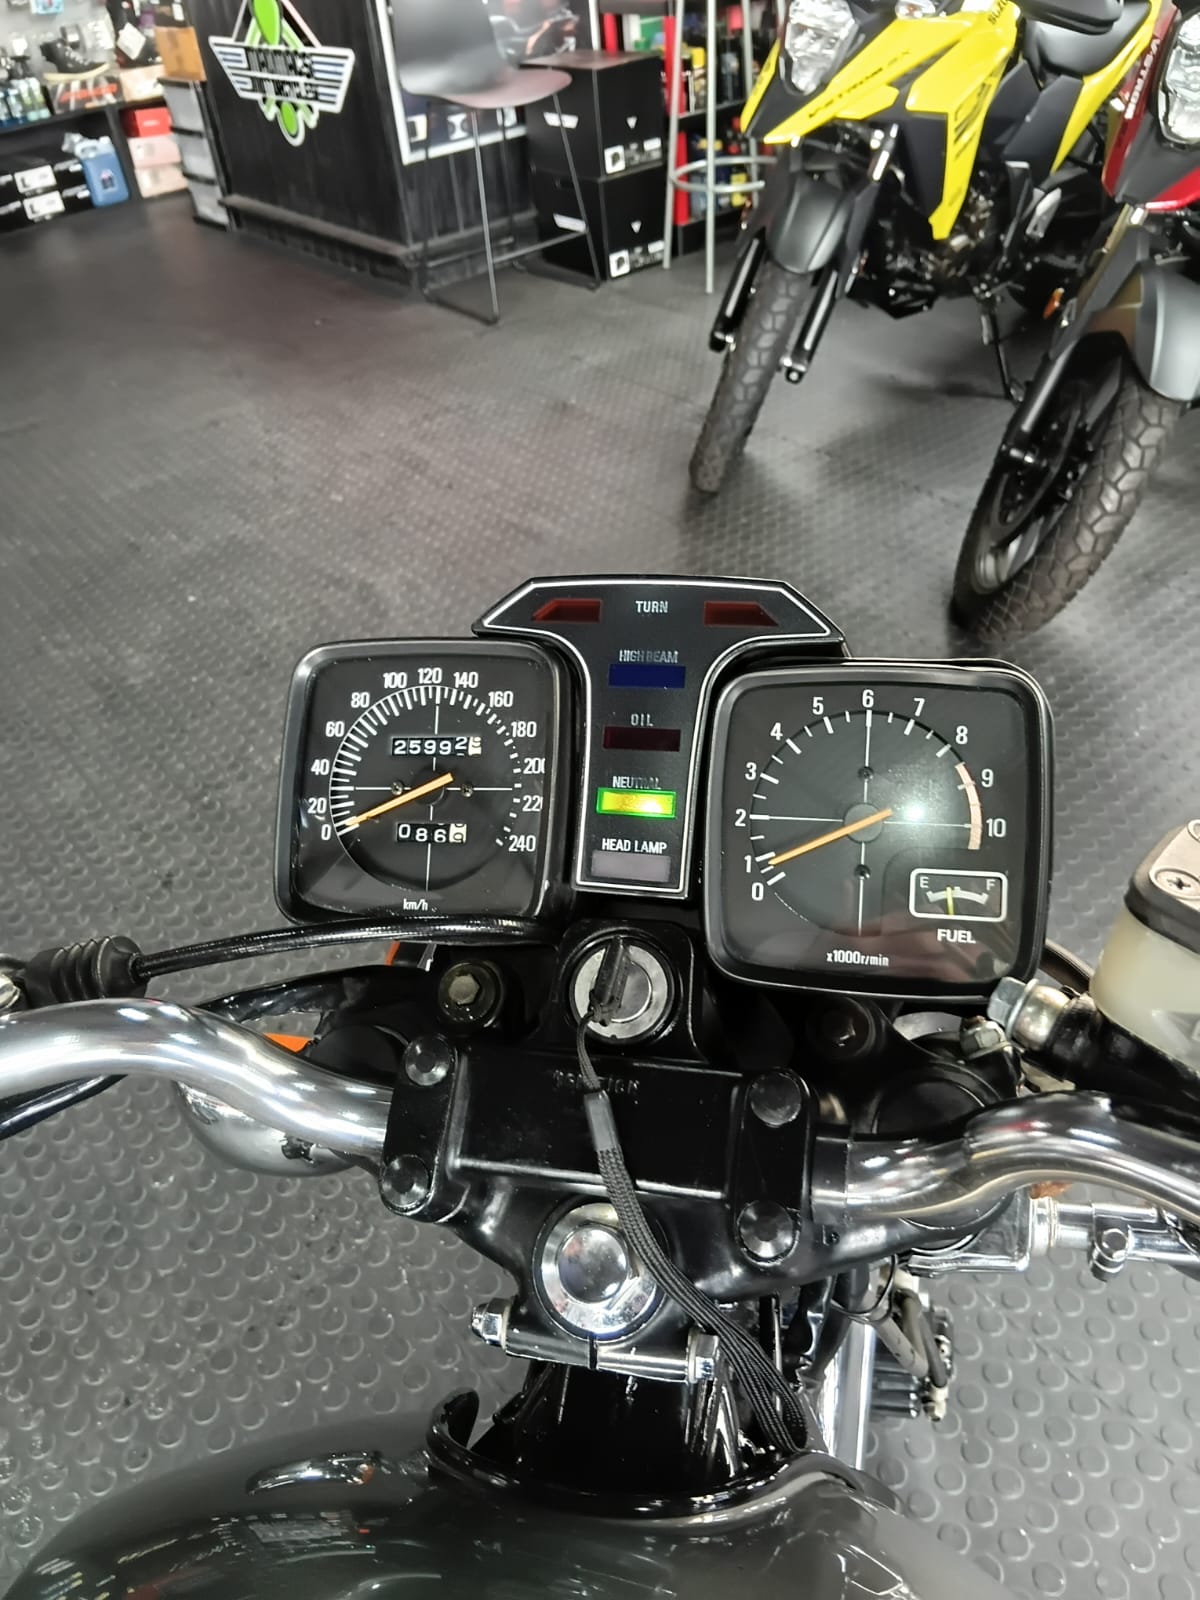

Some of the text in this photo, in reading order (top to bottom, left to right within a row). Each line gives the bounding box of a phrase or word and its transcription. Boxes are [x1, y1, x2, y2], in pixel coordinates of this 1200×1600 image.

[635, 600, 669, 613] TURN
[619, 649, 645, 662] HIGH
[382, 671, 408, 688] 100
[417, 667, 443, 684] 120
[453, 671, 479, 688] 140
[350, 691, 371, 708] 80
[488, 690, 514, 707] 160
[812, 696, 825, 715] 5
[862, 689, 875, 707] 6
[913, 697, 926, 716] 7
[325, 720, 345, 738] 60
[630, 713, 654, 727] OIL
[510, 720, 537, 739] 180
[769, 722, 784, 741] 4
[955, 725, 969, 745] 8
[310, 758, 330, 777] 40
[744, 761, 757, 781] 3
[981, 768, 995, 788] 9
[307, 797, 327, 815] 20
[734, 808, 747, 828] 2
[320, 823, 332, 841] 0
[985, 818, 1007, 838] 10
[508, 834, 537, 852] 240
[601, 837, 668, 855] HEAD LAMP
[744, 854, 753, 873] 1
[751, 881, 765, 902] 0
[919, 876, 930, 889] E
[985, 878, 997, 891] F
[402, 898, 429, 912] km/h
[936, 928, 977, 944] FUEL
[826, 949, 890, 968] x1000r/min
